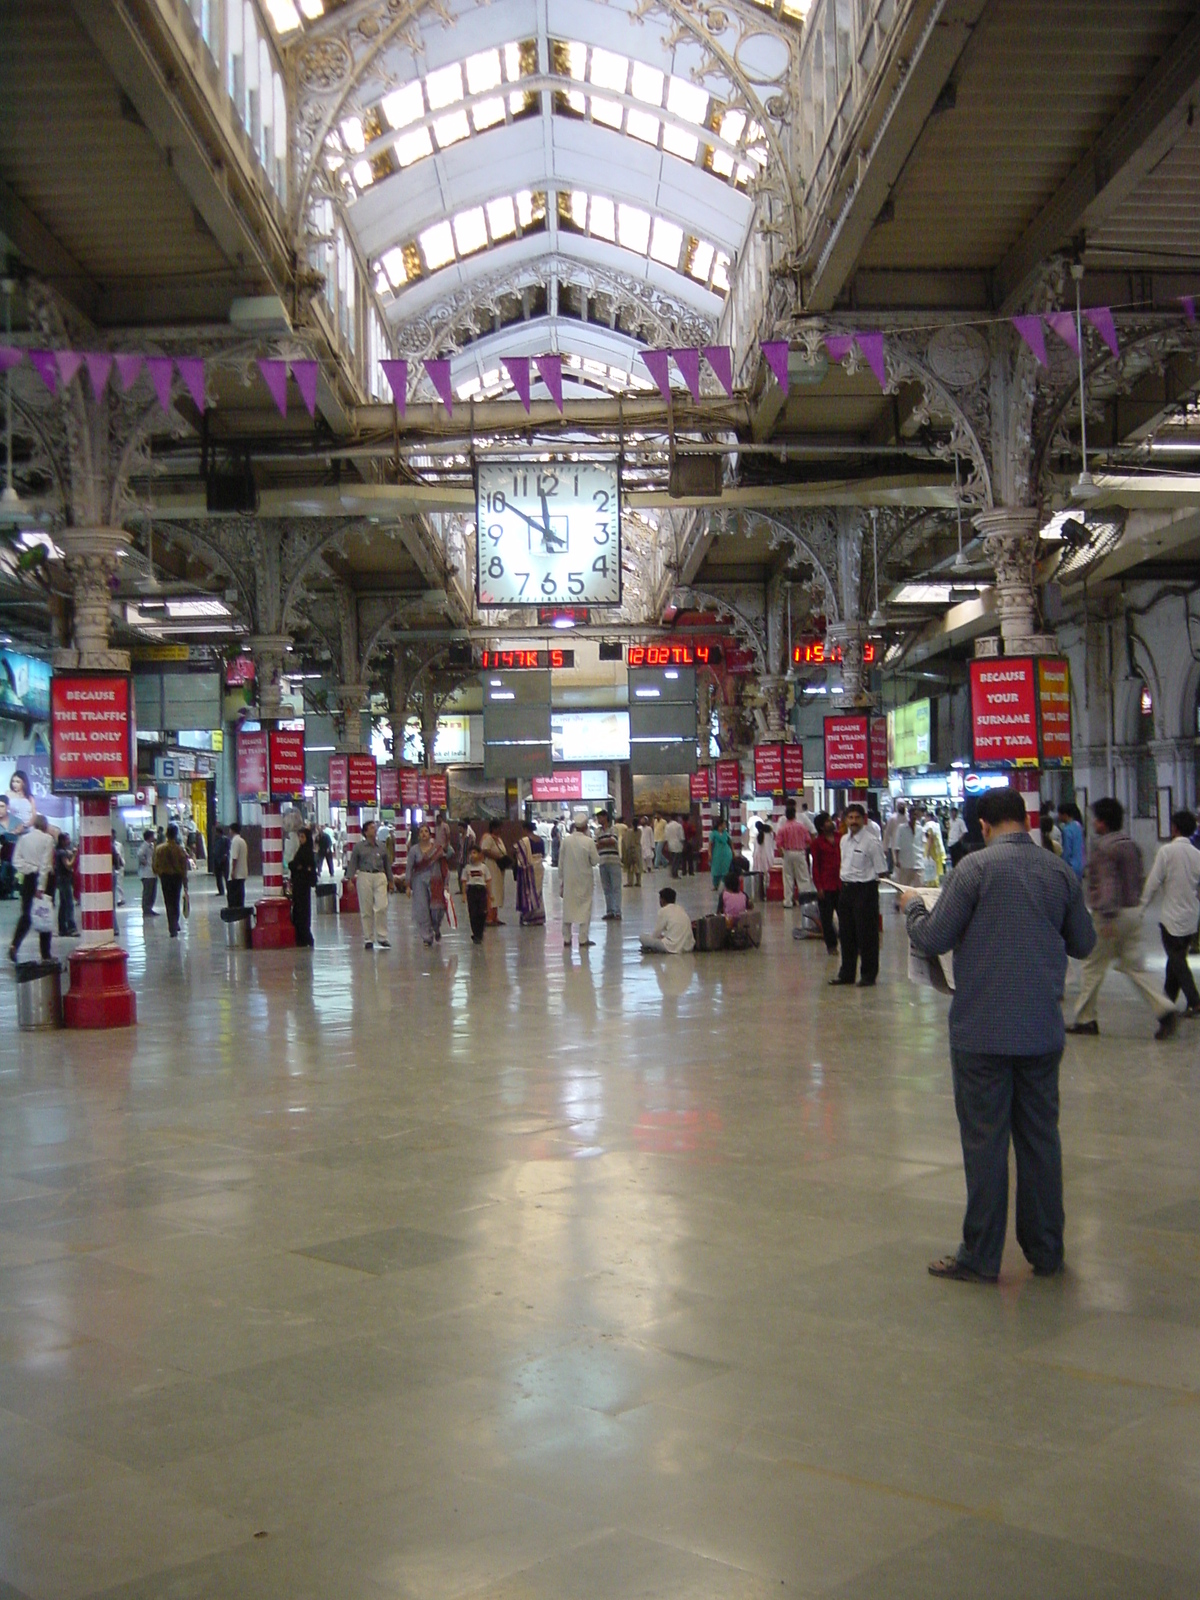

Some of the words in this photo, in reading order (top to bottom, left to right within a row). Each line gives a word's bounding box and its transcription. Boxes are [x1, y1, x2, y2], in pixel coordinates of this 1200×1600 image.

[513, 475, 527, 497] 11
[537, 474, 559, 497] 12
[574, 475, 579, 497] 1
[486, 491, 505, 513] 10
[593, 490, 609, 512] 2
[487, 524, 504, 547] 9
[593, 523, 609, 545] 3
[487, 556, 504, 579] 8
[592, 555, 609, 578] 4
[514, 573, 530, 595] 7
[541, 572, 557, 595] 6
[568, 572, 585, 595] 5
[697, 646, 709, 664] 4
[980, 671, 1026, 683] BECAUSE
[66, 691, 117, 701] BECAUSE
[987, 693, 1019, 704] YOUR
[55, 711, 79, 721] THE
[80, 711, 128, 721] TRAFFIC
[977, 714, 1031, 726] SURNAME
[60, 731, 88, 742] WILL
[90, 731, 123, 742] ONLY
[1004, 735, 1033, 746] TATA
[60, 752, 81, 762] GET
[83, 752, 123, 762] WORSE
[163, 760, 174, 778] 6
